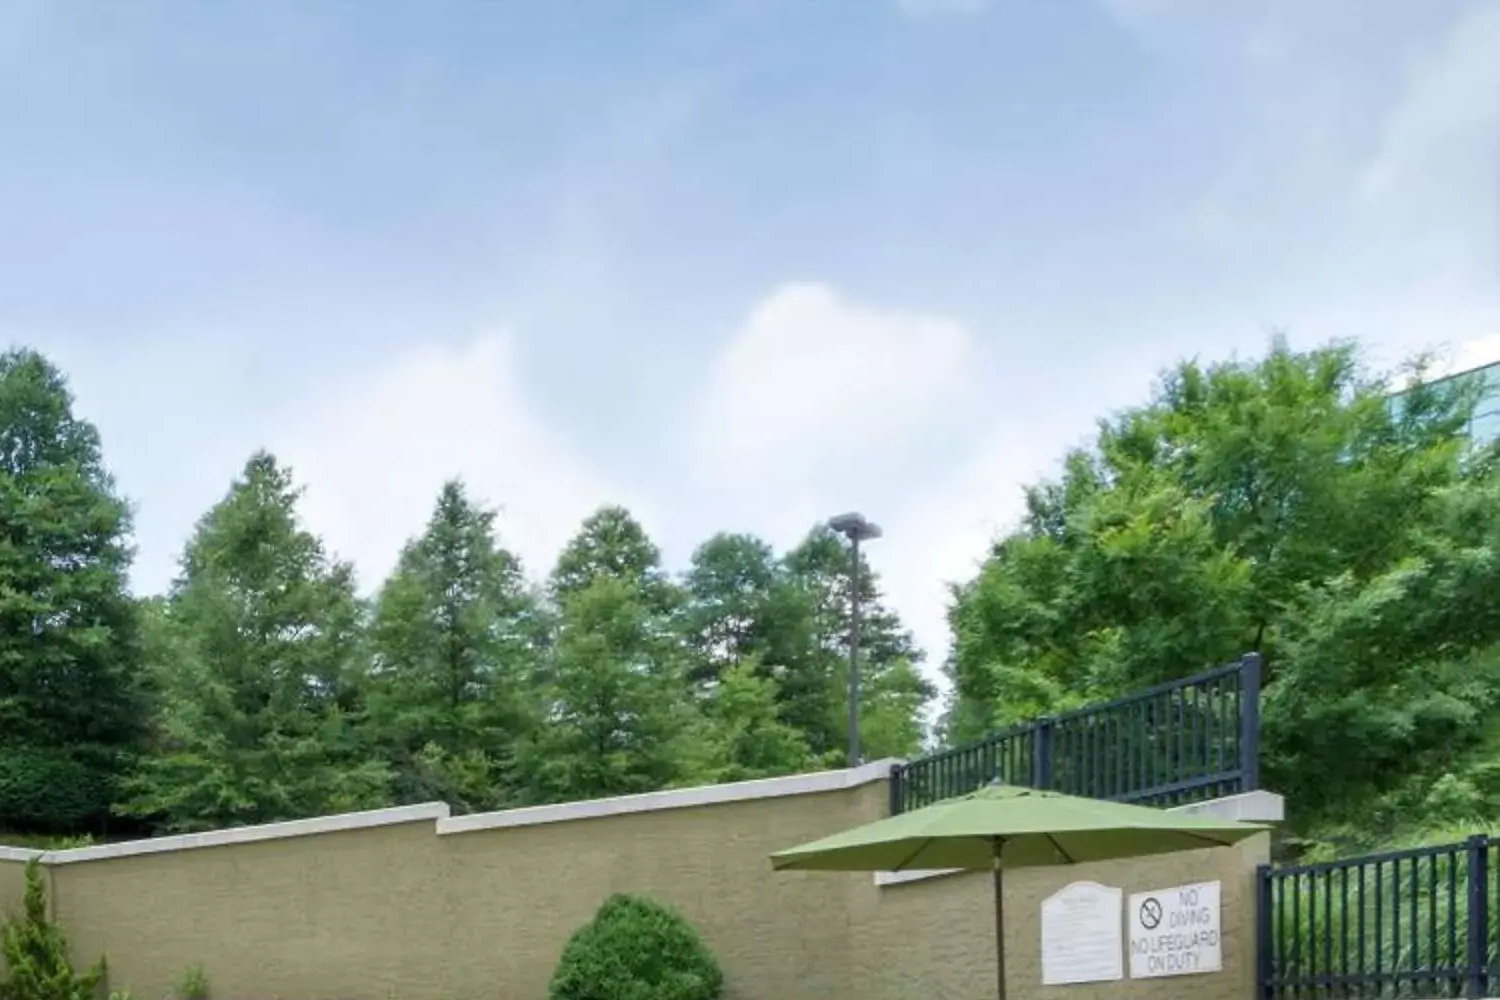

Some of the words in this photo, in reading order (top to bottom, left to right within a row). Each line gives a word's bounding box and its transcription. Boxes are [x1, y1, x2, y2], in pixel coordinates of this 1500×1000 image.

[1179, 888, 1199, 907] NO
[1169, 905, 1210, 929] DIVING
[1130, 937, 1148, 955] NO
[1151, 929, 1218, 953] LIFEGUARD
[1147, 954, 1166, 973] ON
[1167, 951, 1199, 971] DUTY
